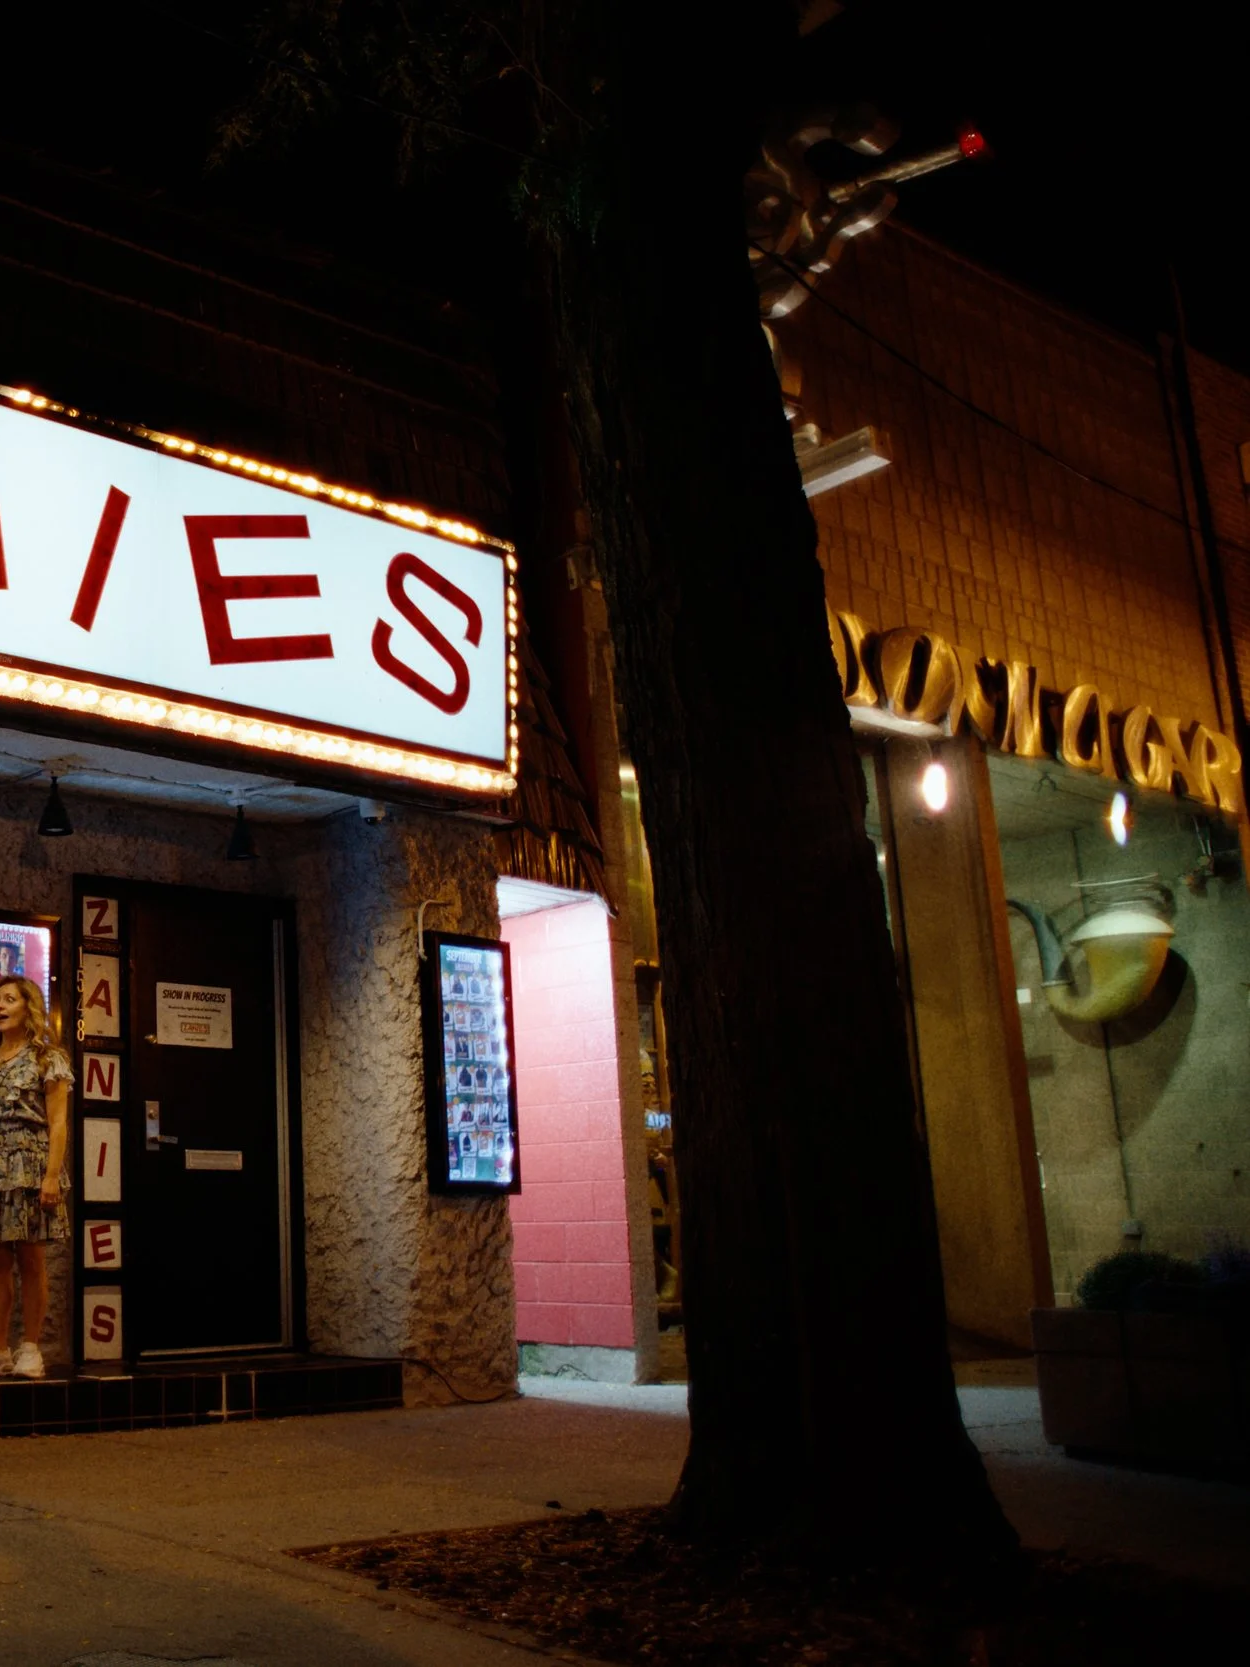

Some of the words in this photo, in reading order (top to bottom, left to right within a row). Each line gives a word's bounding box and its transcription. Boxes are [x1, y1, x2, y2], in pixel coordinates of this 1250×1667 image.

[1062, 684, 1241, 812] CIGAR
[162, 989, 183, 1000] SHOW
[184, 991, 191, 1001] IN
[192, 991, 226, 1003] PROGRESS
[85, 899, 116, 1343] ZANIES
